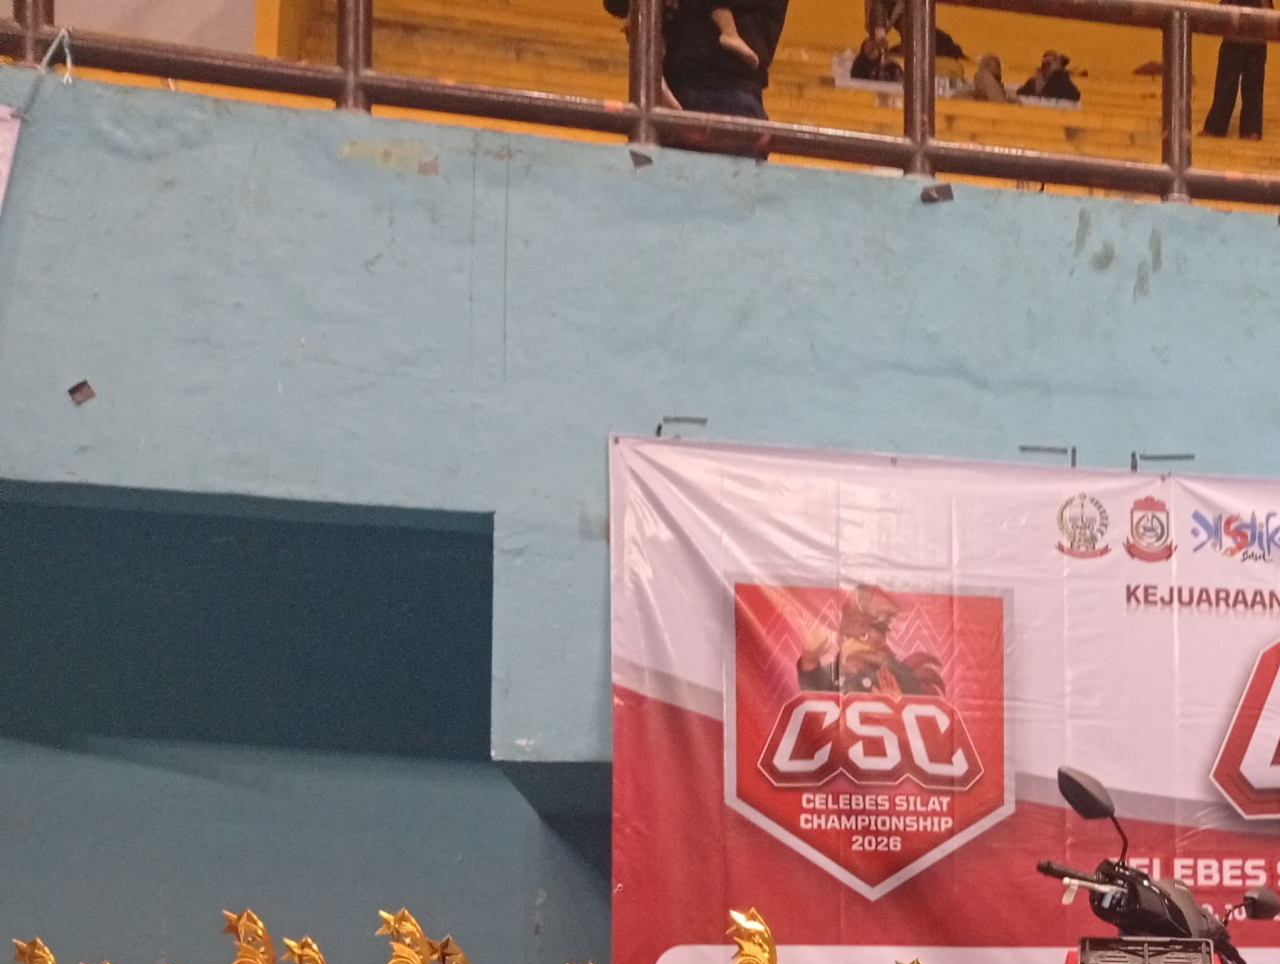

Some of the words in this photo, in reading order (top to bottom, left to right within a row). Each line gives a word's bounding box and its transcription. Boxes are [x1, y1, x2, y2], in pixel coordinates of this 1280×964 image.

[772, 700, 969, 778] CSC
[802, 793, 890, 811] CELEBES
[895, 795, 951, 812] SILAT
[800, 813, 954, 832] CHAMPIONSHIP
[851, 836, 902, 852] 2026
[1107, 857, 1266, 888] ELEBES
